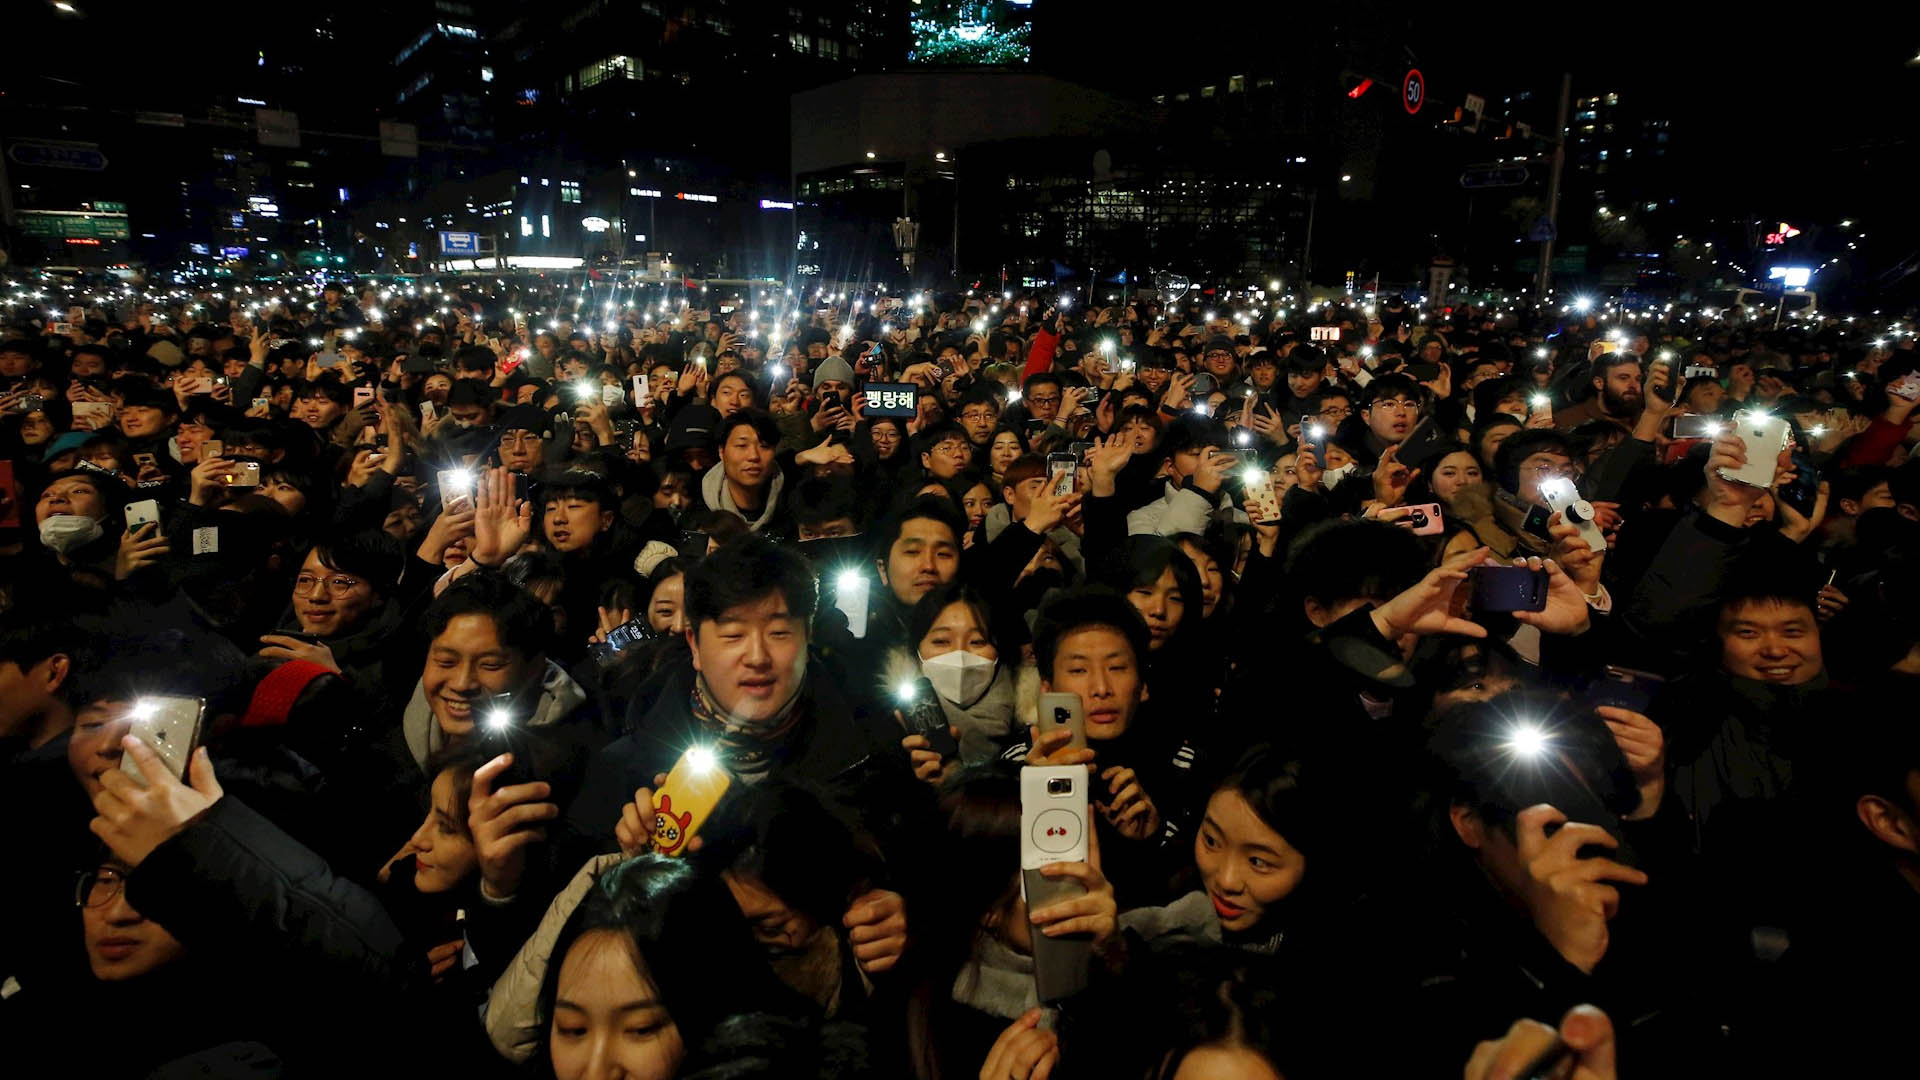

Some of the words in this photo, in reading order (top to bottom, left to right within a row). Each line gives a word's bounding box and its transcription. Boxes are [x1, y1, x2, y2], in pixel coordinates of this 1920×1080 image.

[1407, 80, 1420, 103] 50
[1765, 233, 1785, 245] SK
[866, 390, 914, 409] 펭랑해
